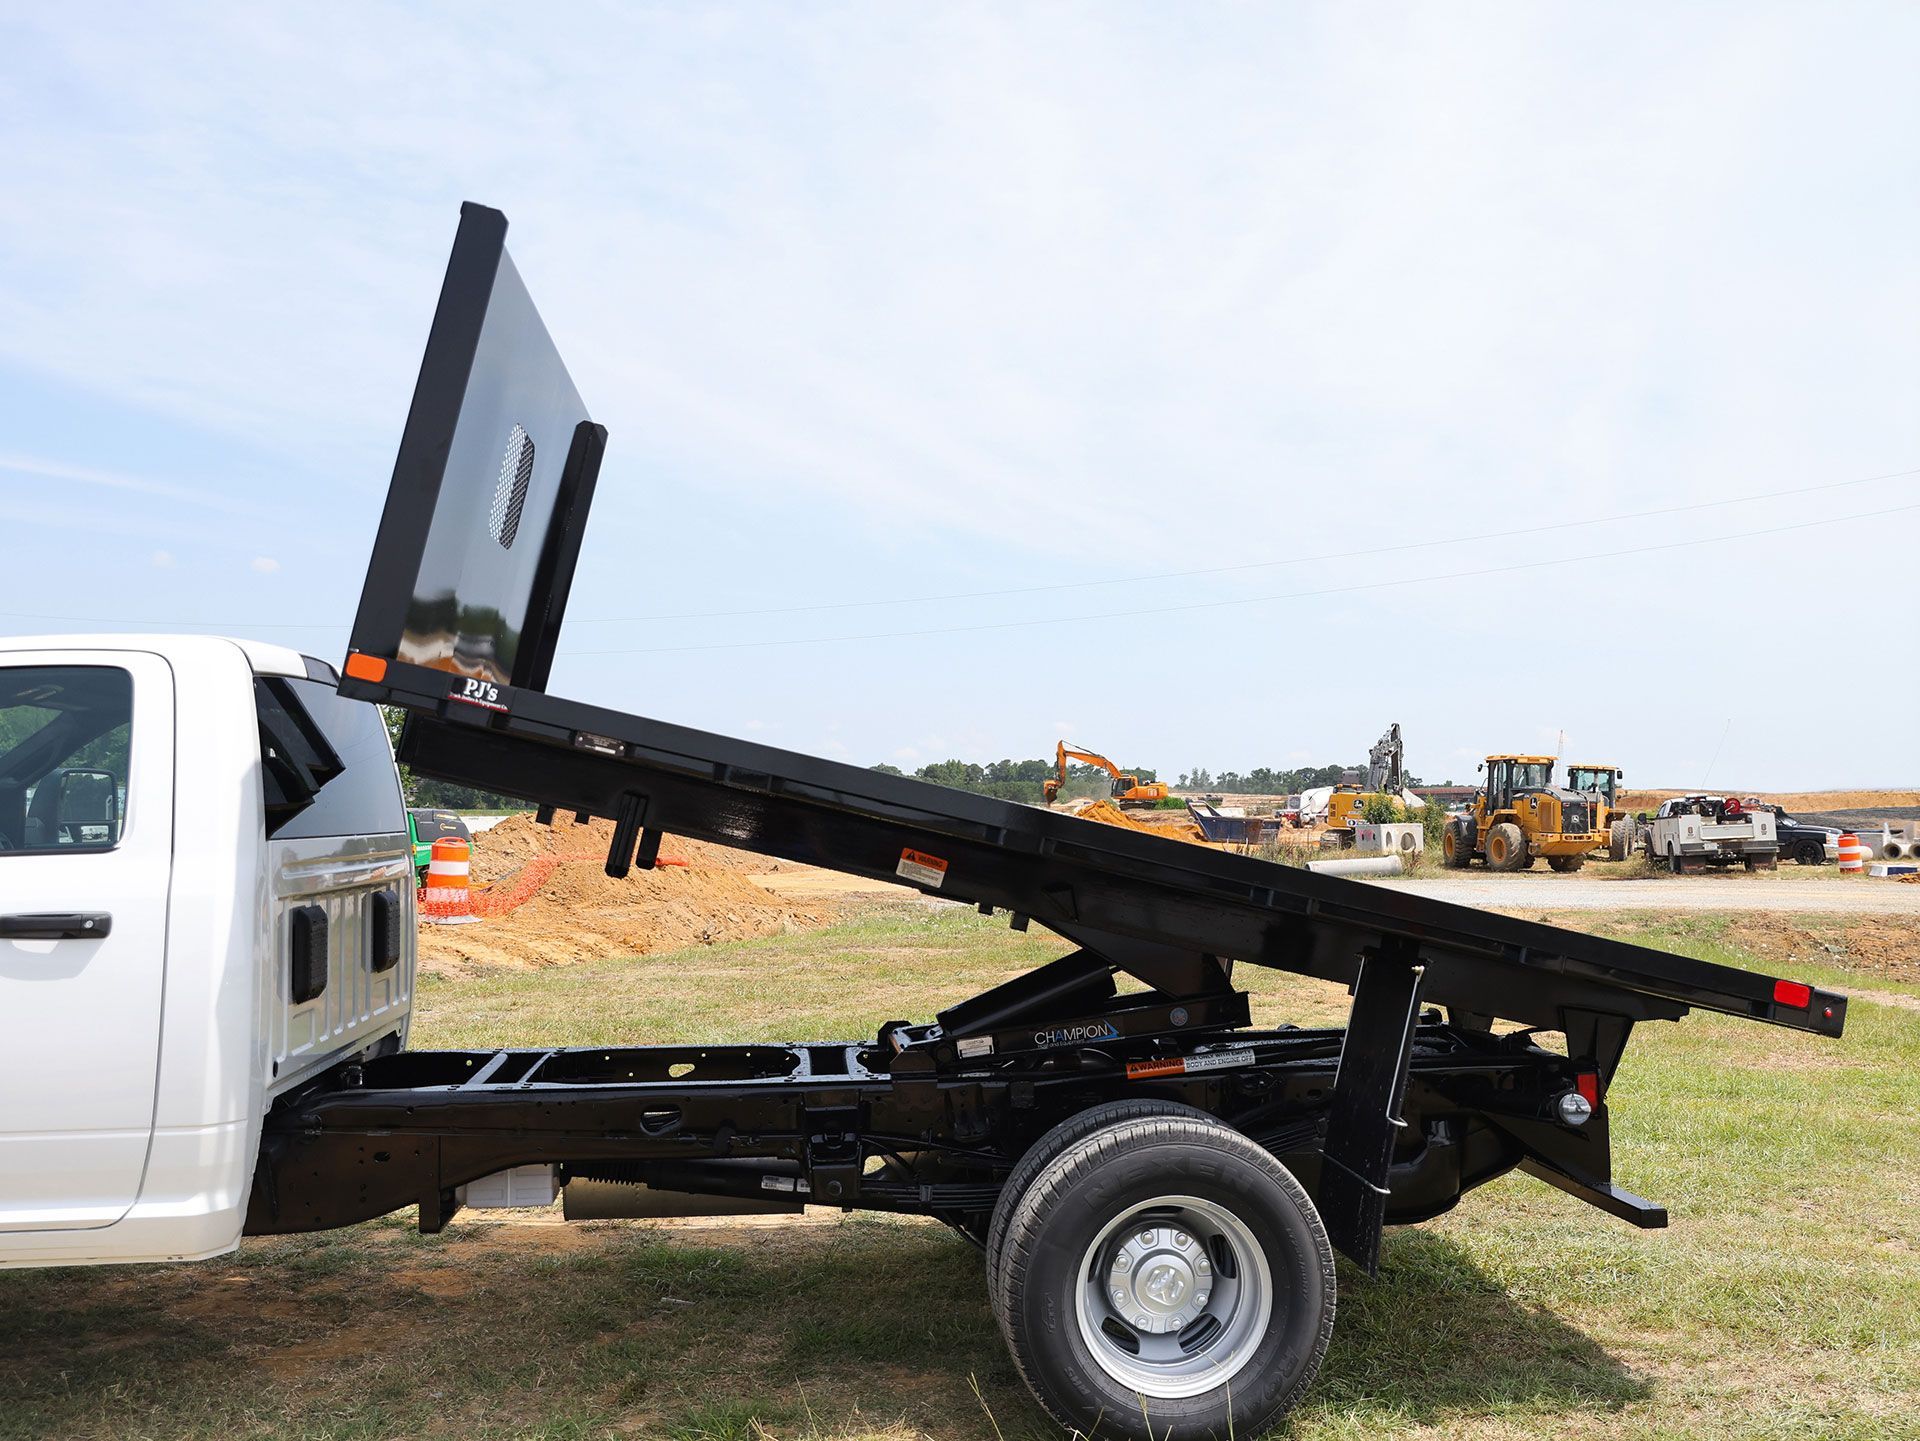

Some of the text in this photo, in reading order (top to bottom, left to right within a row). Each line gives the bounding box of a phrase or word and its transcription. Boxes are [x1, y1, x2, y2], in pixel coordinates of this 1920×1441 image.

[463, 678, 499, 702] PJ's
[1034, 1024, 1109, 1045] CHAMPION
[1140, 1058, 1183, 1072] WARNING
[1186, 1061, 1202, 1069] BODY
[1203, 1059, 1217, 1067] AND
[1217, 1056, 1240, 1065] ENGINE
[1199, 1053, 1214, 1061] ONLY
[1084, 1156, 1255, 1212] NEXEN
